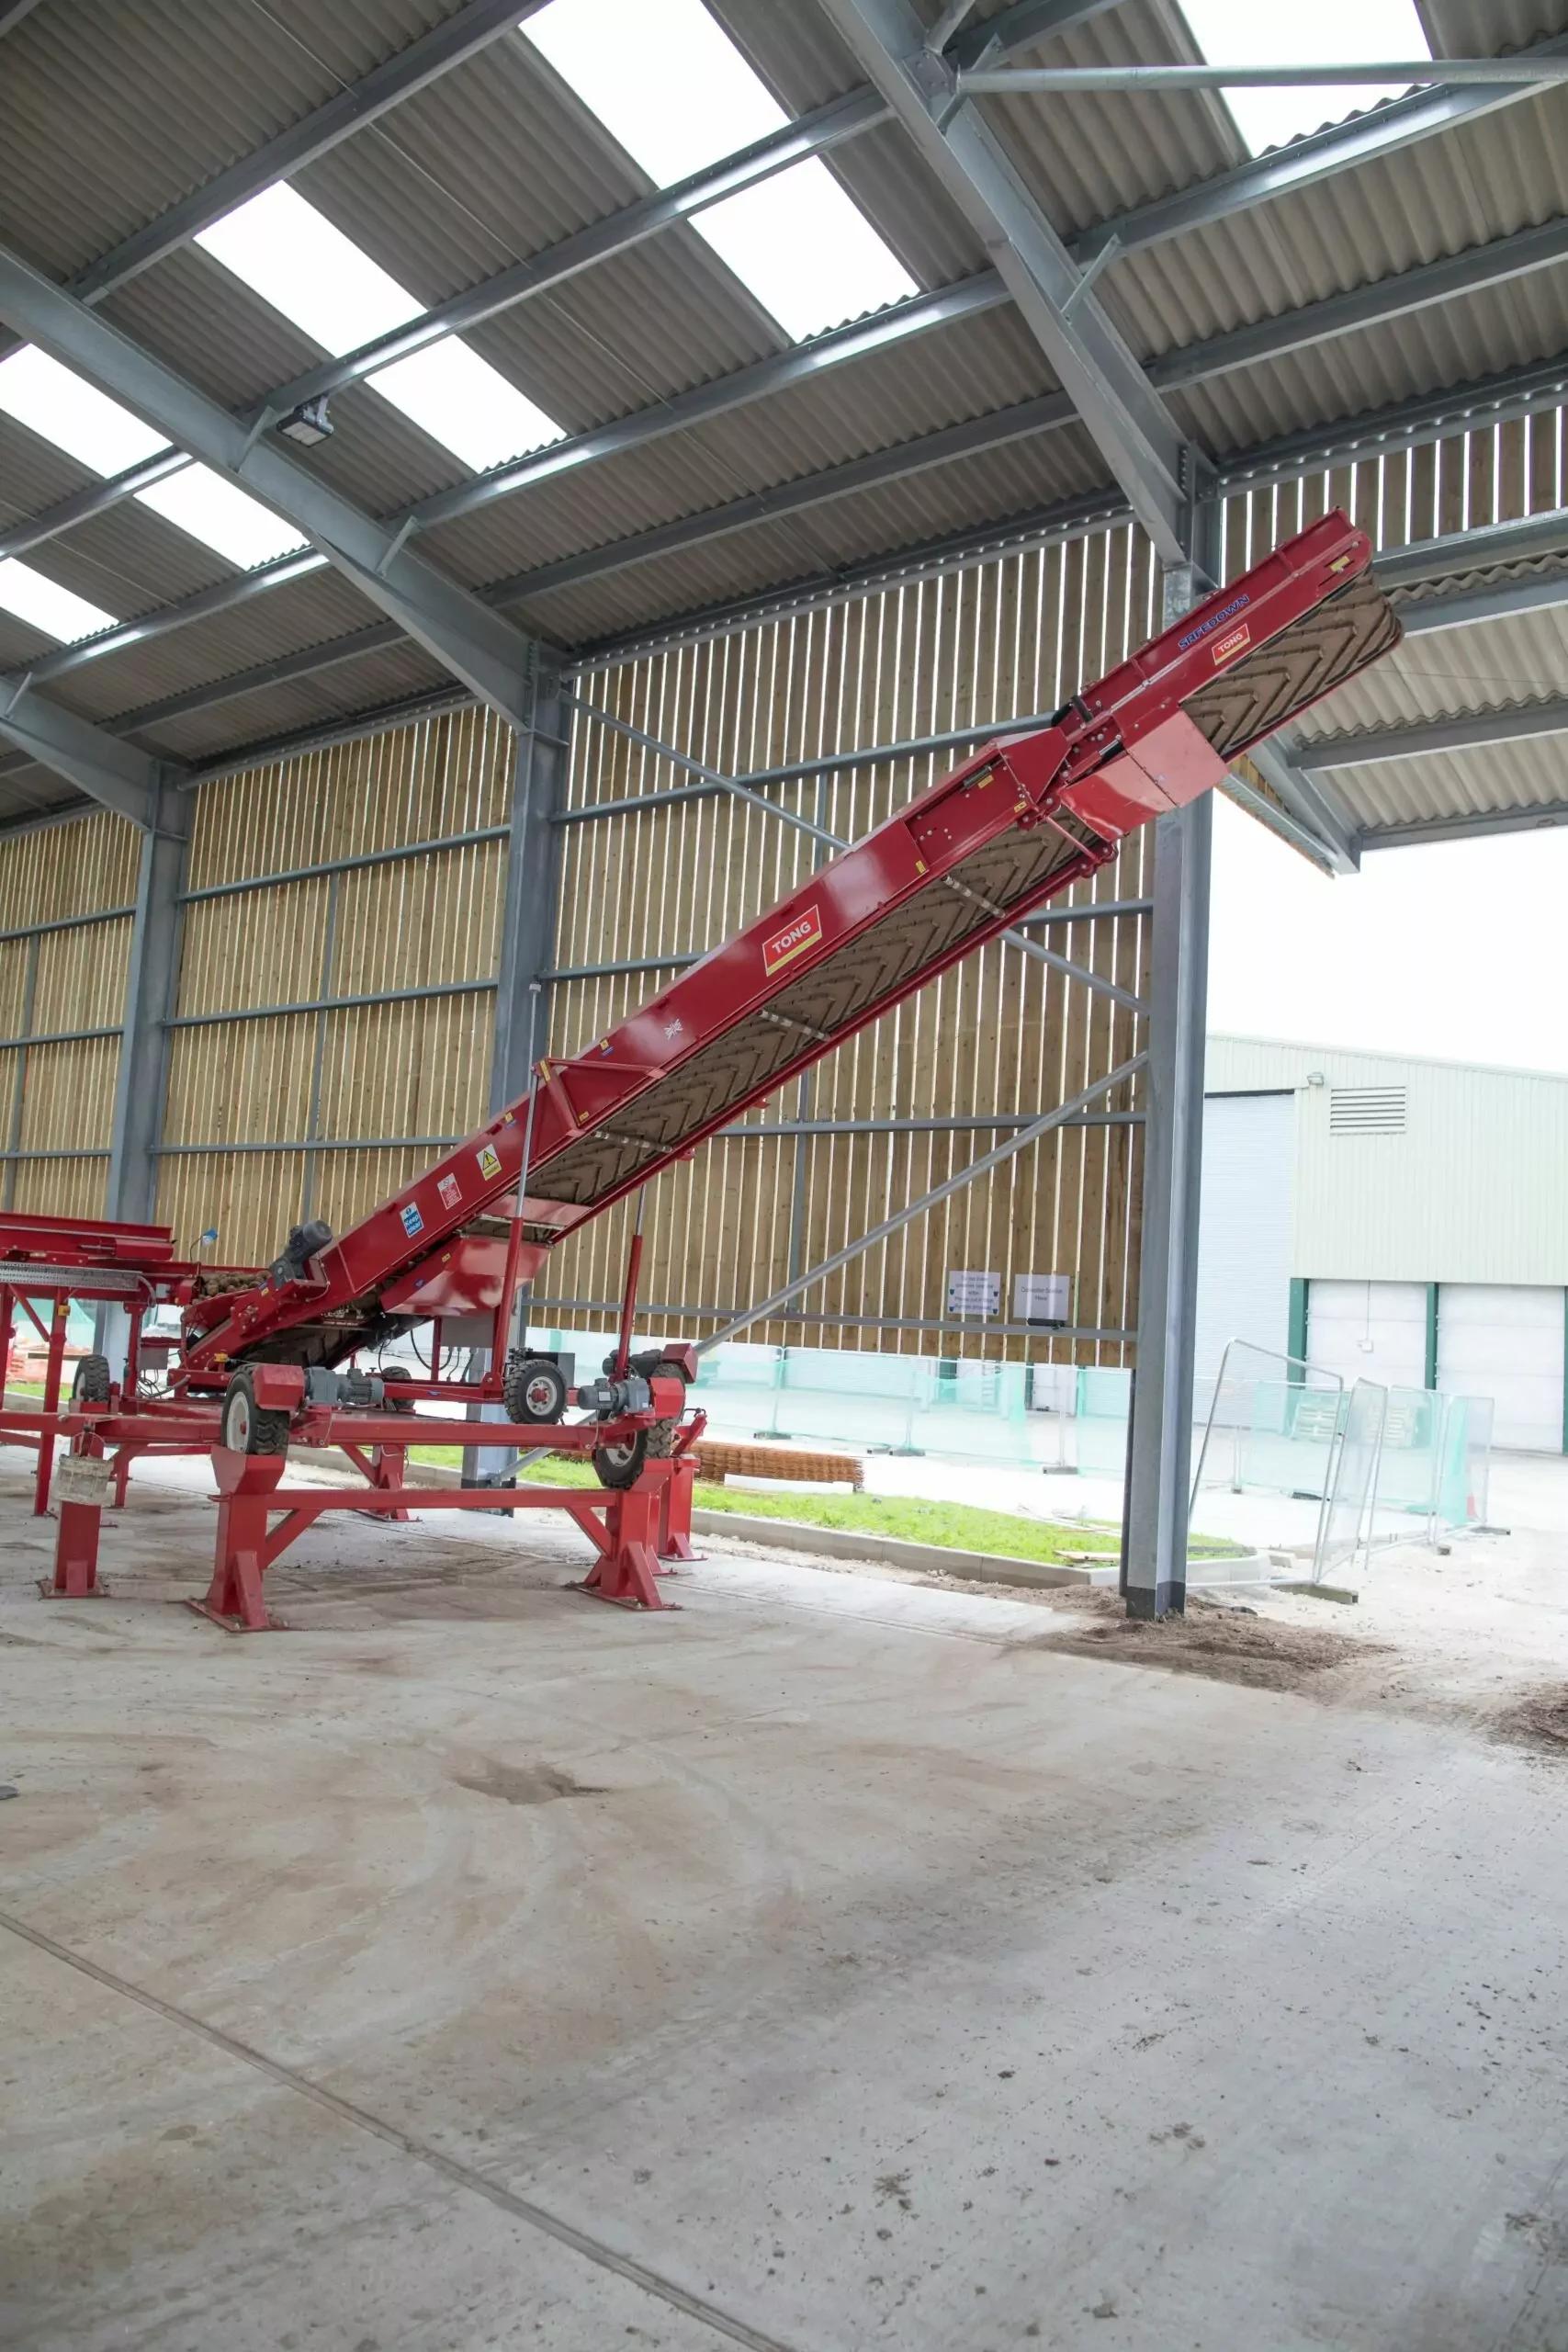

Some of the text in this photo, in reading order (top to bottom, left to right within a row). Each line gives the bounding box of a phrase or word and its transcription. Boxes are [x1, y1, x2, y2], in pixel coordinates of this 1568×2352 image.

[1179, 594, 1249, 650] SAFEDOWN
[1218, 633, 1243, 652] TONG
[772, 921, 811, 954] TONG
[404, 1214, 420, 1226] Keep
[408, 1222, 421, 1234] clear
